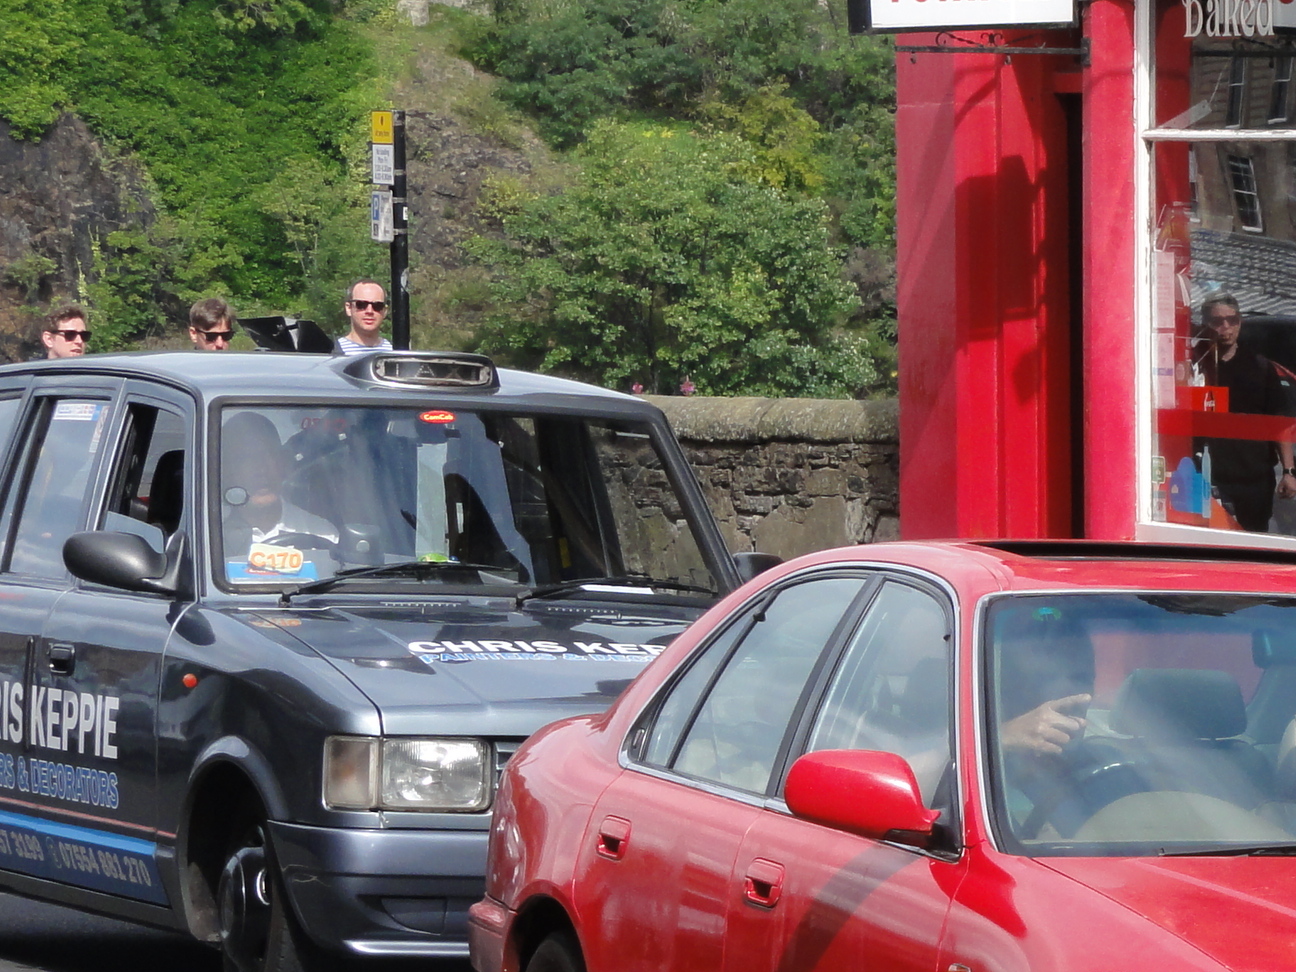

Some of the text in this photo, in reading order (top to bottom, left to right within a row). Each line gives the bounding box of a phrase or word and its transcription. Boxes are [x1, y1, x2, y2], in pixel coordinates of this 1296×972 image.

[250, 551, 302, 568] C170
[408, 640, 568, 654] CHRIS
[419, 652, 556, 664] PAINTERS
[563, 652, 588, 662] &
[0, 680, 120, 760] IS KEPPIE
[17, 755, 30, 793] &
[30, 758, 120, 809] DECORATORS
[11, 832, 45, 861] 3199
[57, 841, 100, 874] 07554
[124, 856, 152, 887] 270
